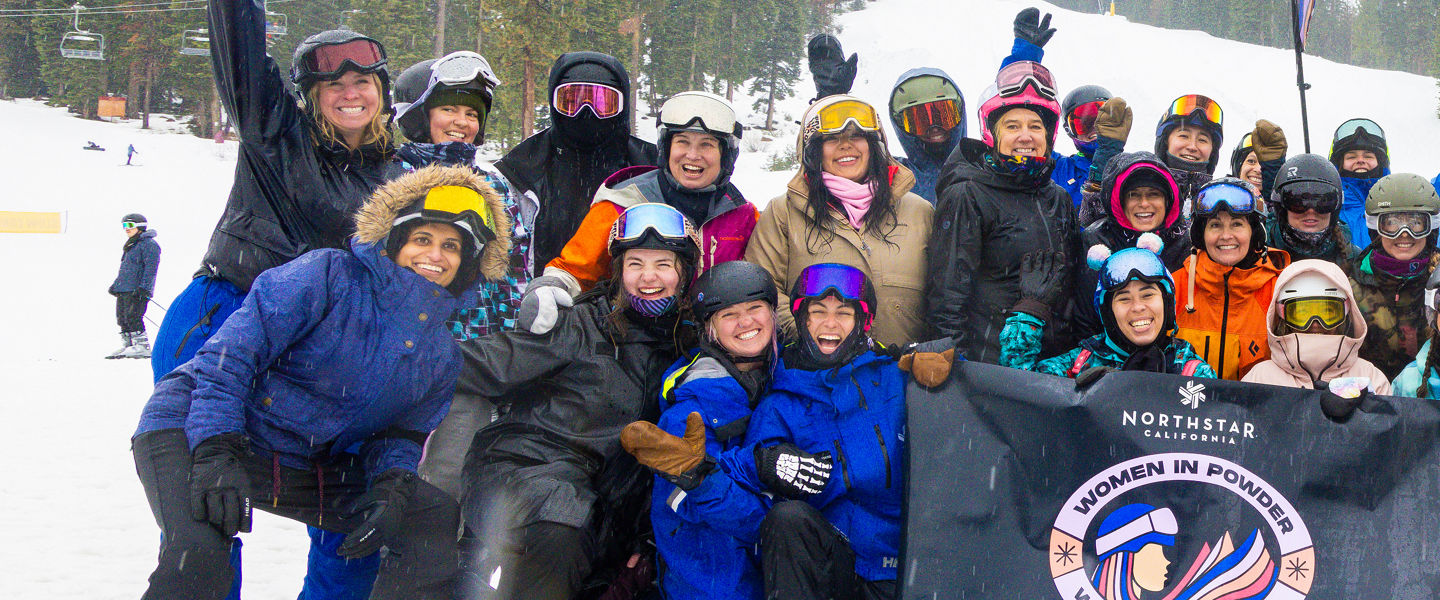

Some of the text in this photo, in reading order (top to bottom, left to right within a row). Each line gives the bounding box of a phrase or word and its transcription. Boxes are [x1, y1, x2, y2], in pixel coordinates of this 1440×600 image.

[1122, 410, 1255, 439] NORTHSTAR
[1144, 429, 1236, 445] CALIFORNIA
[1073, 459, 1294, 535] WOMEN IN POWDER
